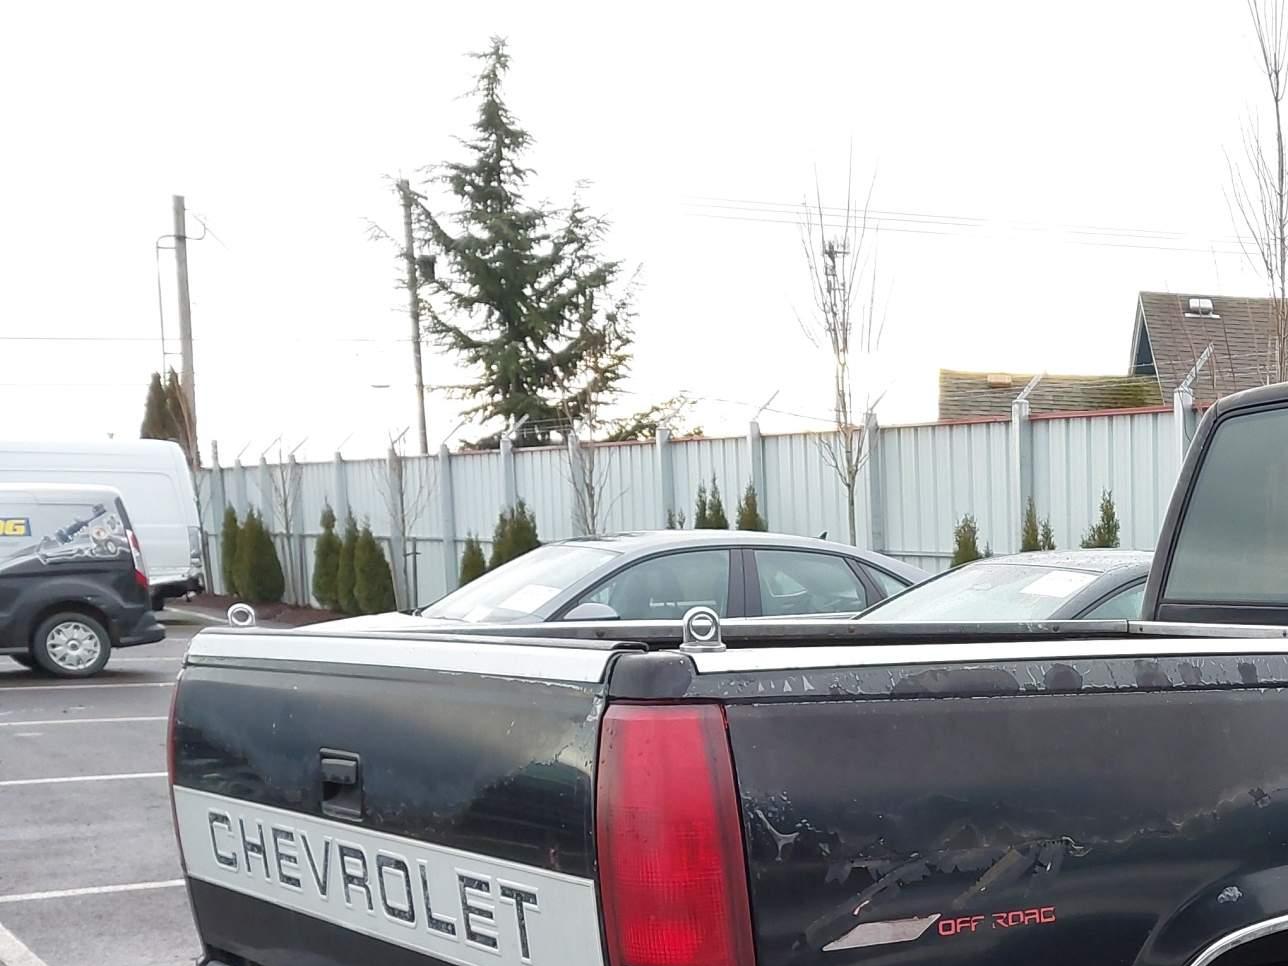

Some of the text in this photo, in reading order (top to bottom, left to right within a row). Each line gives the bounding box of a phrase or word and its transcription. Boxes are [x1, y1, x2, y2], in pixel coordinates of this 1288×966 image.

[0, 519, 25, 535] G
[208, 809, 539, 963] CHEVROLET
[938, 915, 985, 936] OFF
